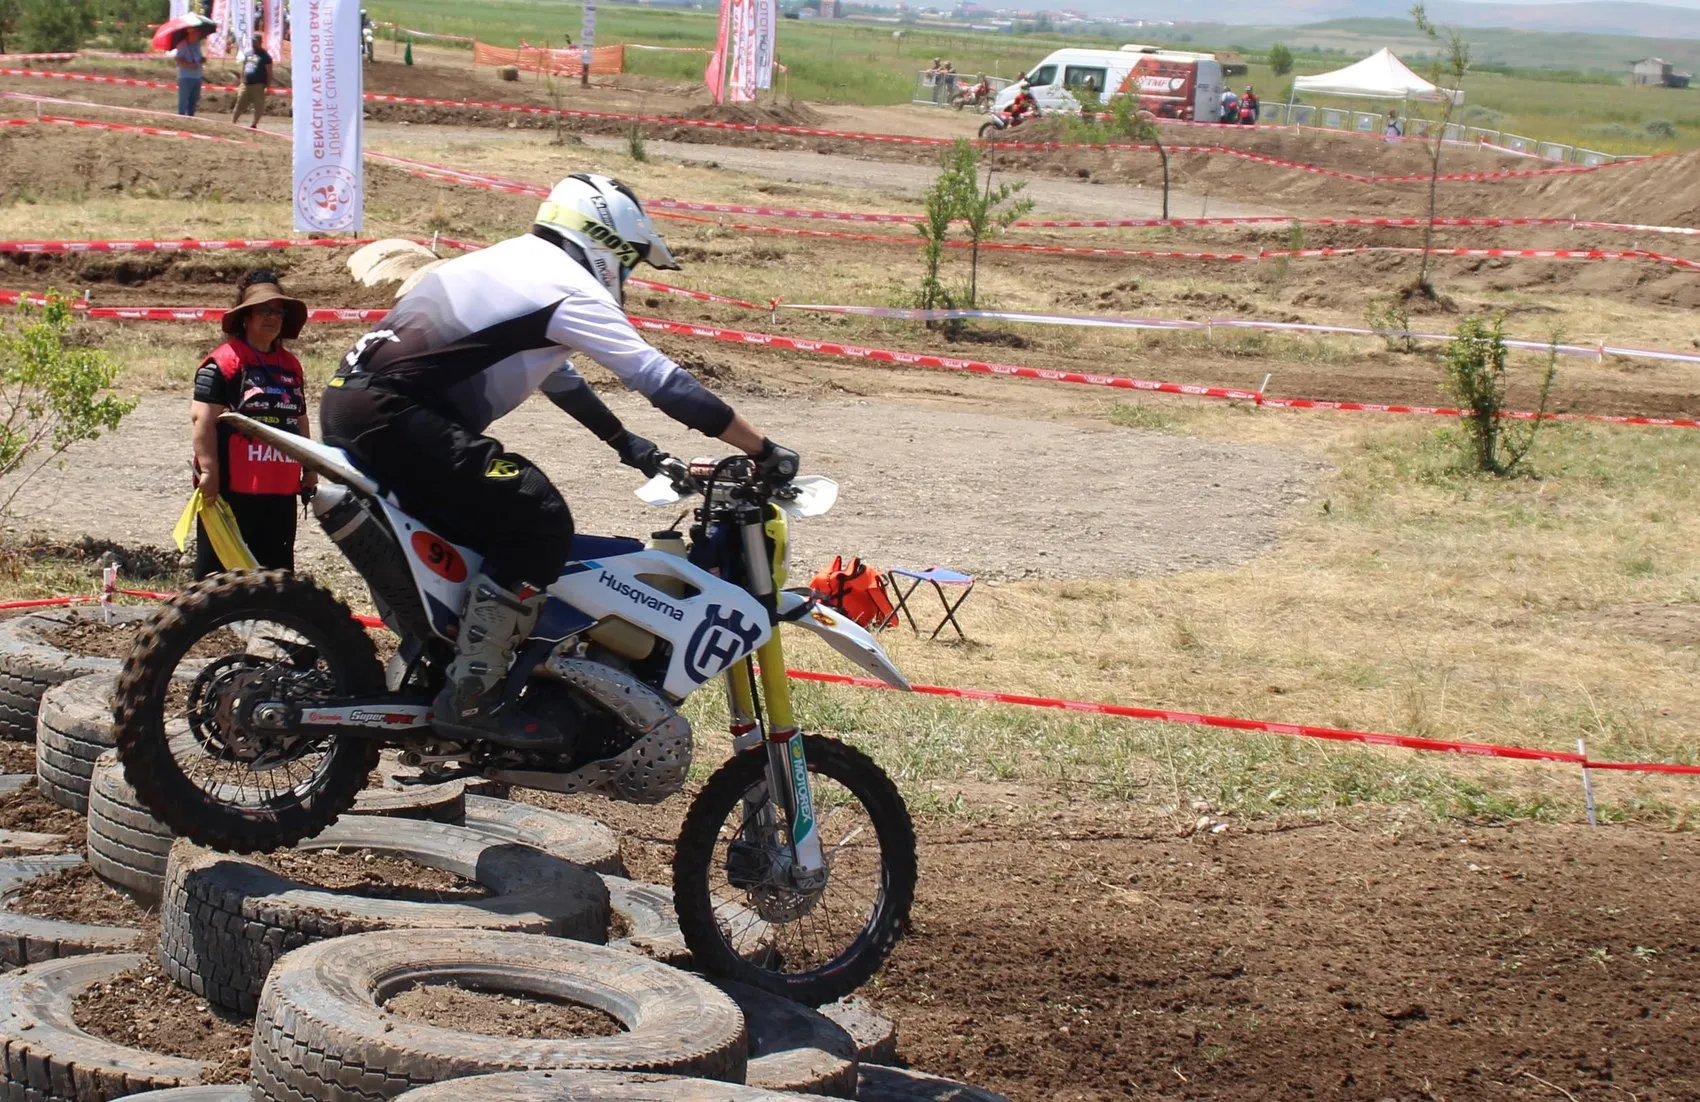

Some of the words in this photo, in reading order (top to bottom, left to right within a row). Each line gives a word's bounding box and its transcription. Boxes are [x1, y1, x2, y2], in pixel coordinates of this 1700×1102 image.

[580, 220, 636, 264] 100%
[428, 542, 454, 572] 91
[598, 570, 684, 622] Husqvarna
[793, 758, 813, 823] MOTOREX
